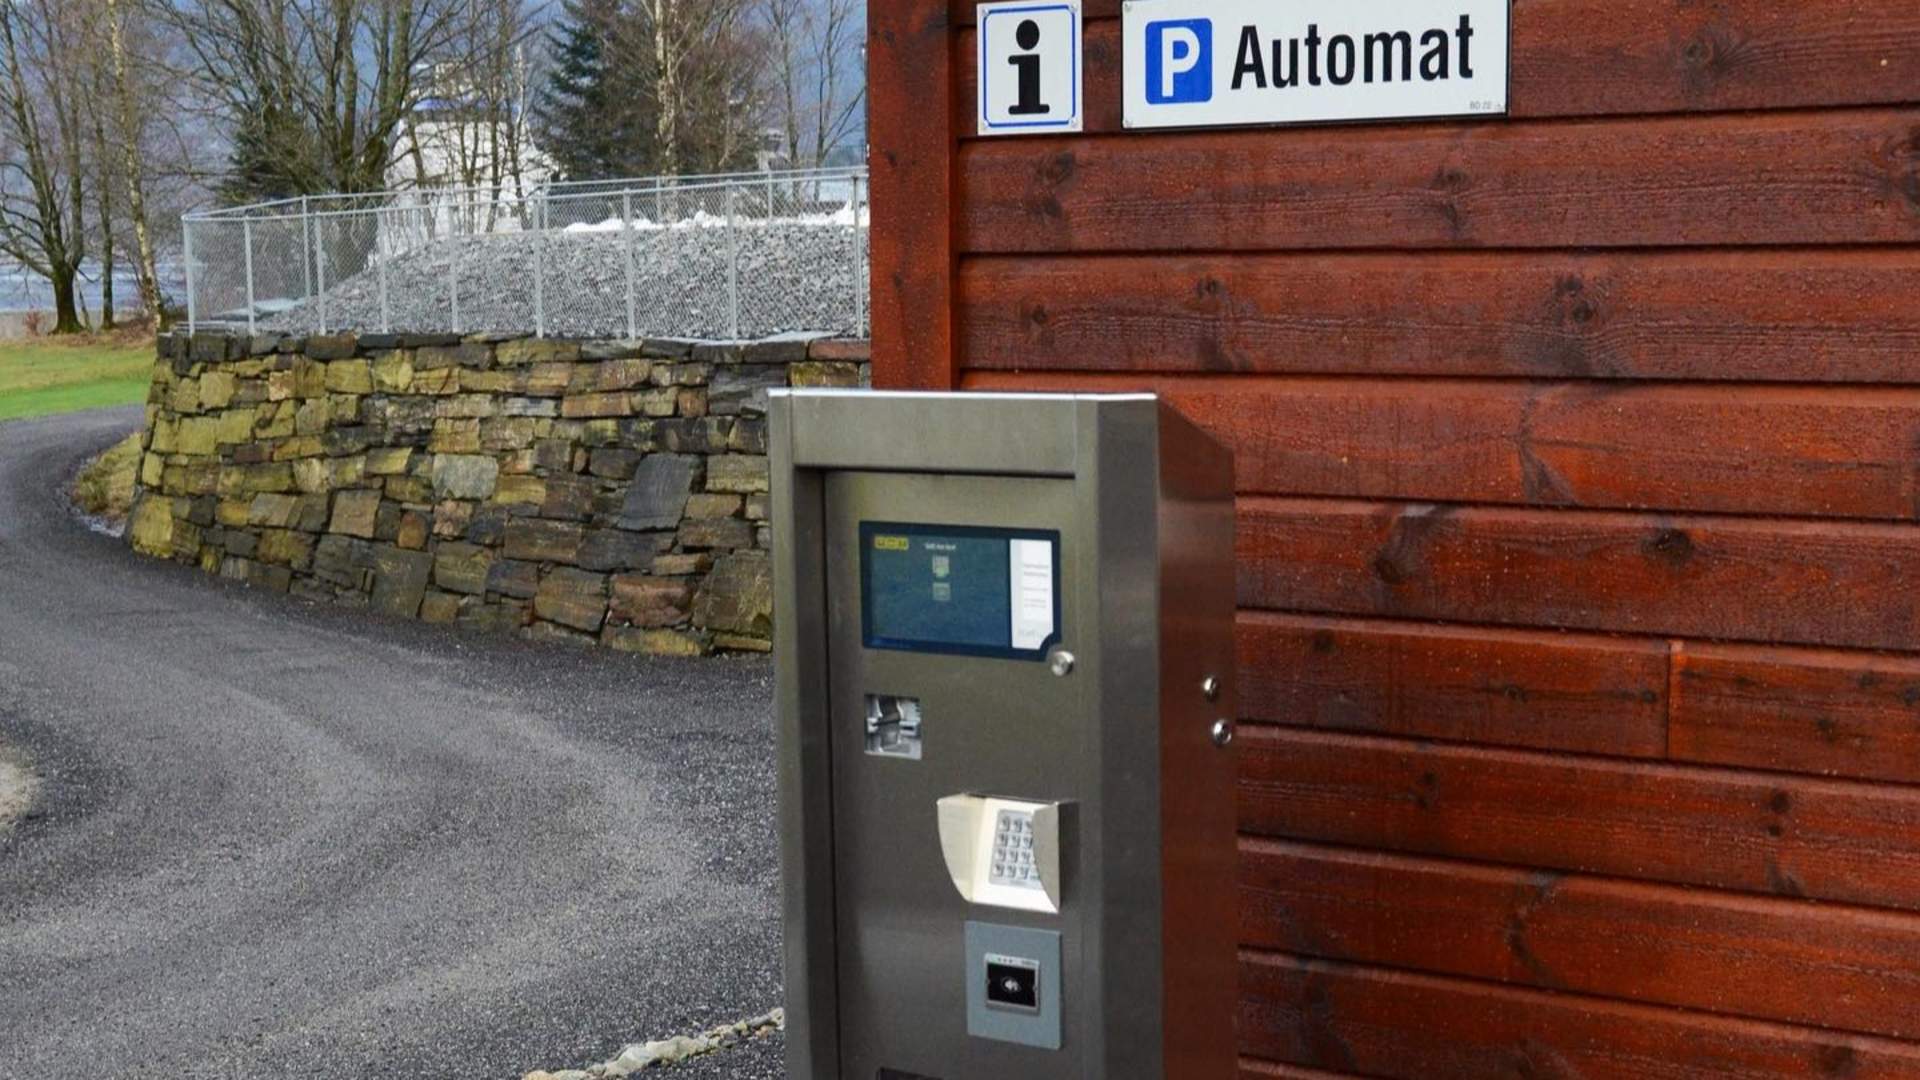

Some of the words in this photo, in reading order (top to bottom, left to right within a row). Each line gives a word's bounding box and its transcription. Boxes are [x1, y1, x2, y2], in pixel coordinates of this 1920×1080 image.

[1008, 19, 1050, 115] i
[1162, 27, 1201, 97] P
[1232, 15, 1474, 90] Automat
